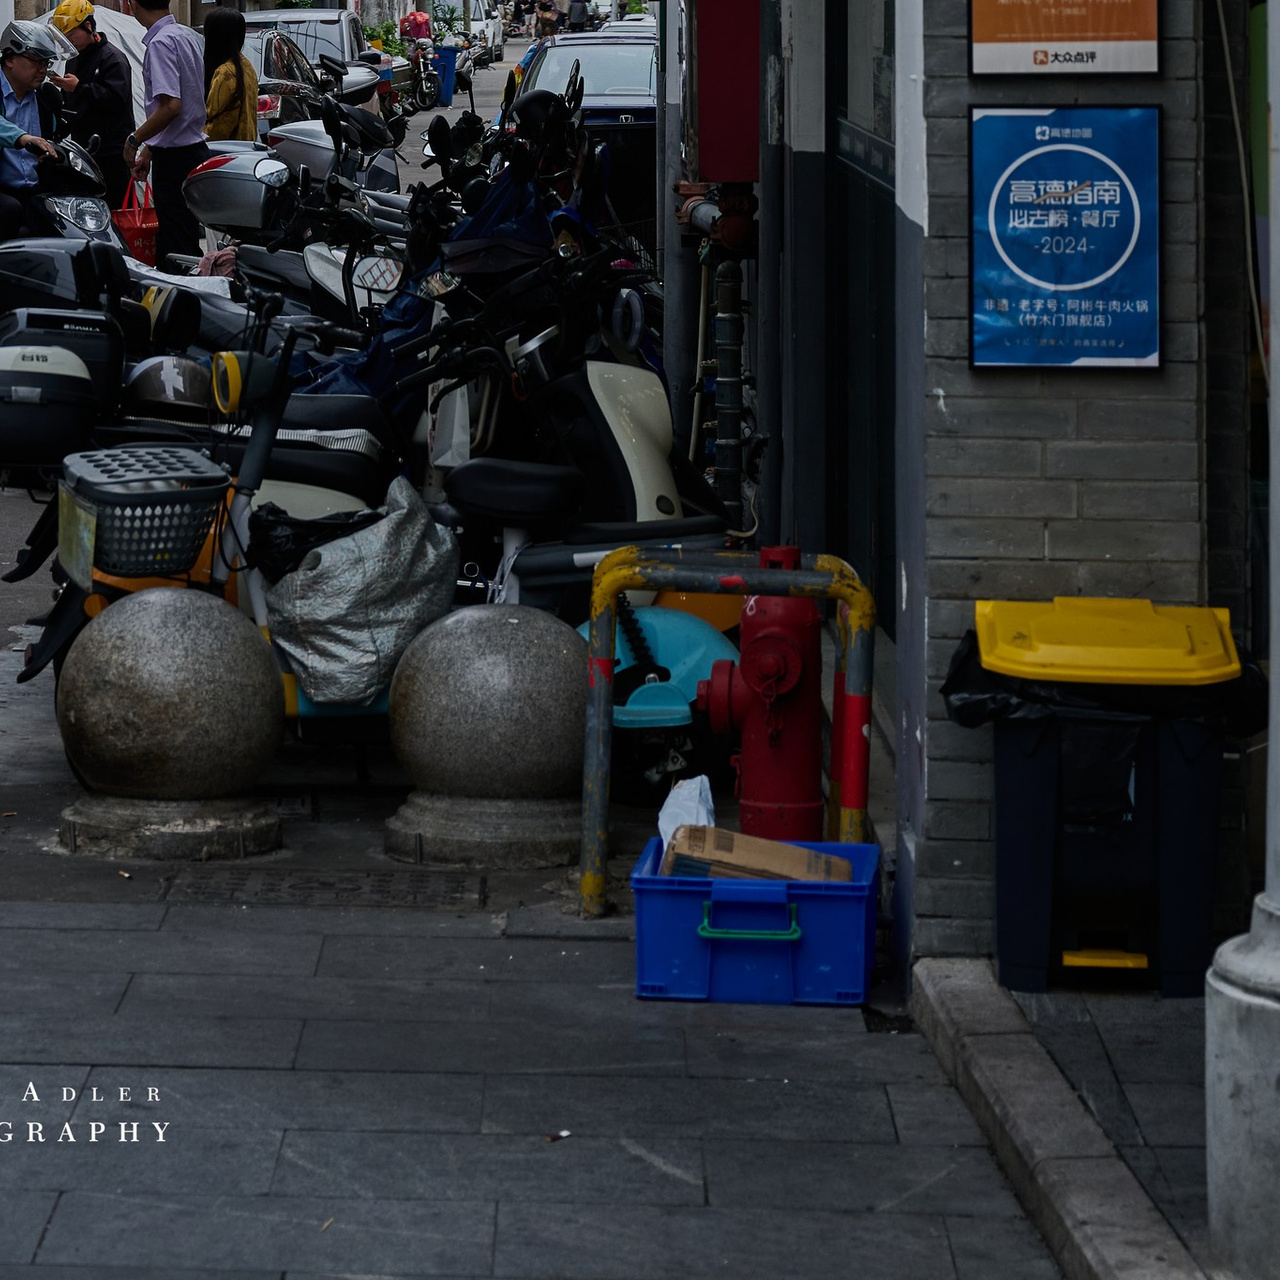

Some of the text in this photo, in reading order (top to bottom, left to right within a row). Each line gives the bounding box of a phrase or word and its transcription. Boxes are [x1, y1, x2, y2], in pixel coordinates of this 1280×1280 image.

[1051, 51, 1097, 63] 大众点评
[1009, 180, 1120, 205] 高德指南
